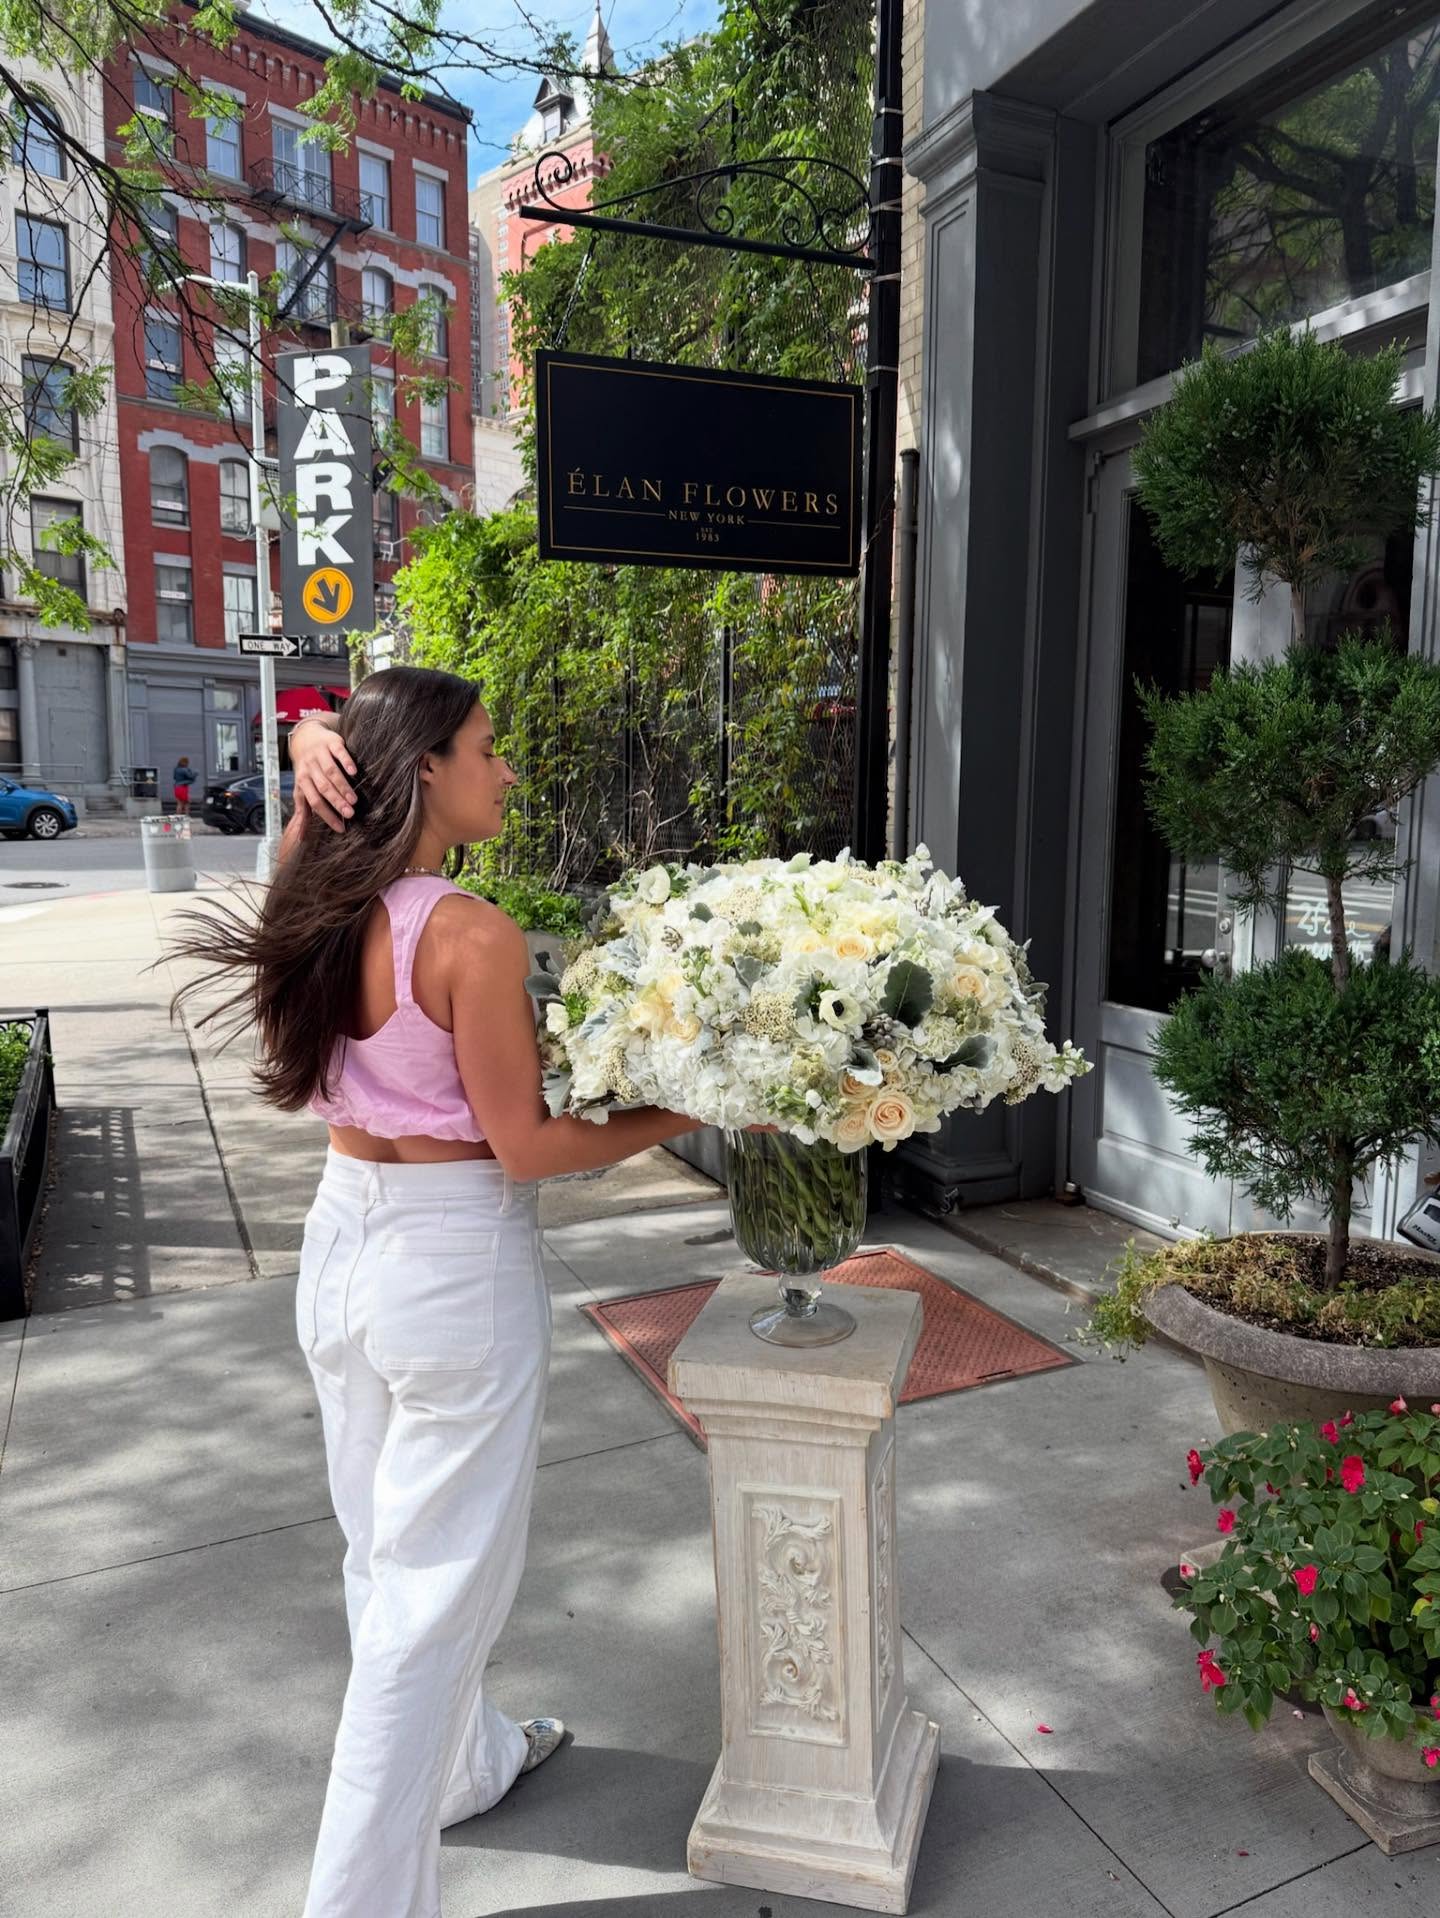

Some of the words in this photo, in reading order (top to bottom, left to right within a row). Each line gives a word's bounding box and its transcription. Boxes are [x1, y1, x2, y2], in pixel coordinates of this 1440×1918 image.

[293, 354, 355, 566] PARK
[566, 467, 663, 502] ÉLAN
[682, 482, 839, 516] FLOWERS
[669, 509, 700, 521] NEW
[707, 512, 745, 525] YORK
[247, 641, 264, 650] ONE
[273, 642, 291, 650] WAY
